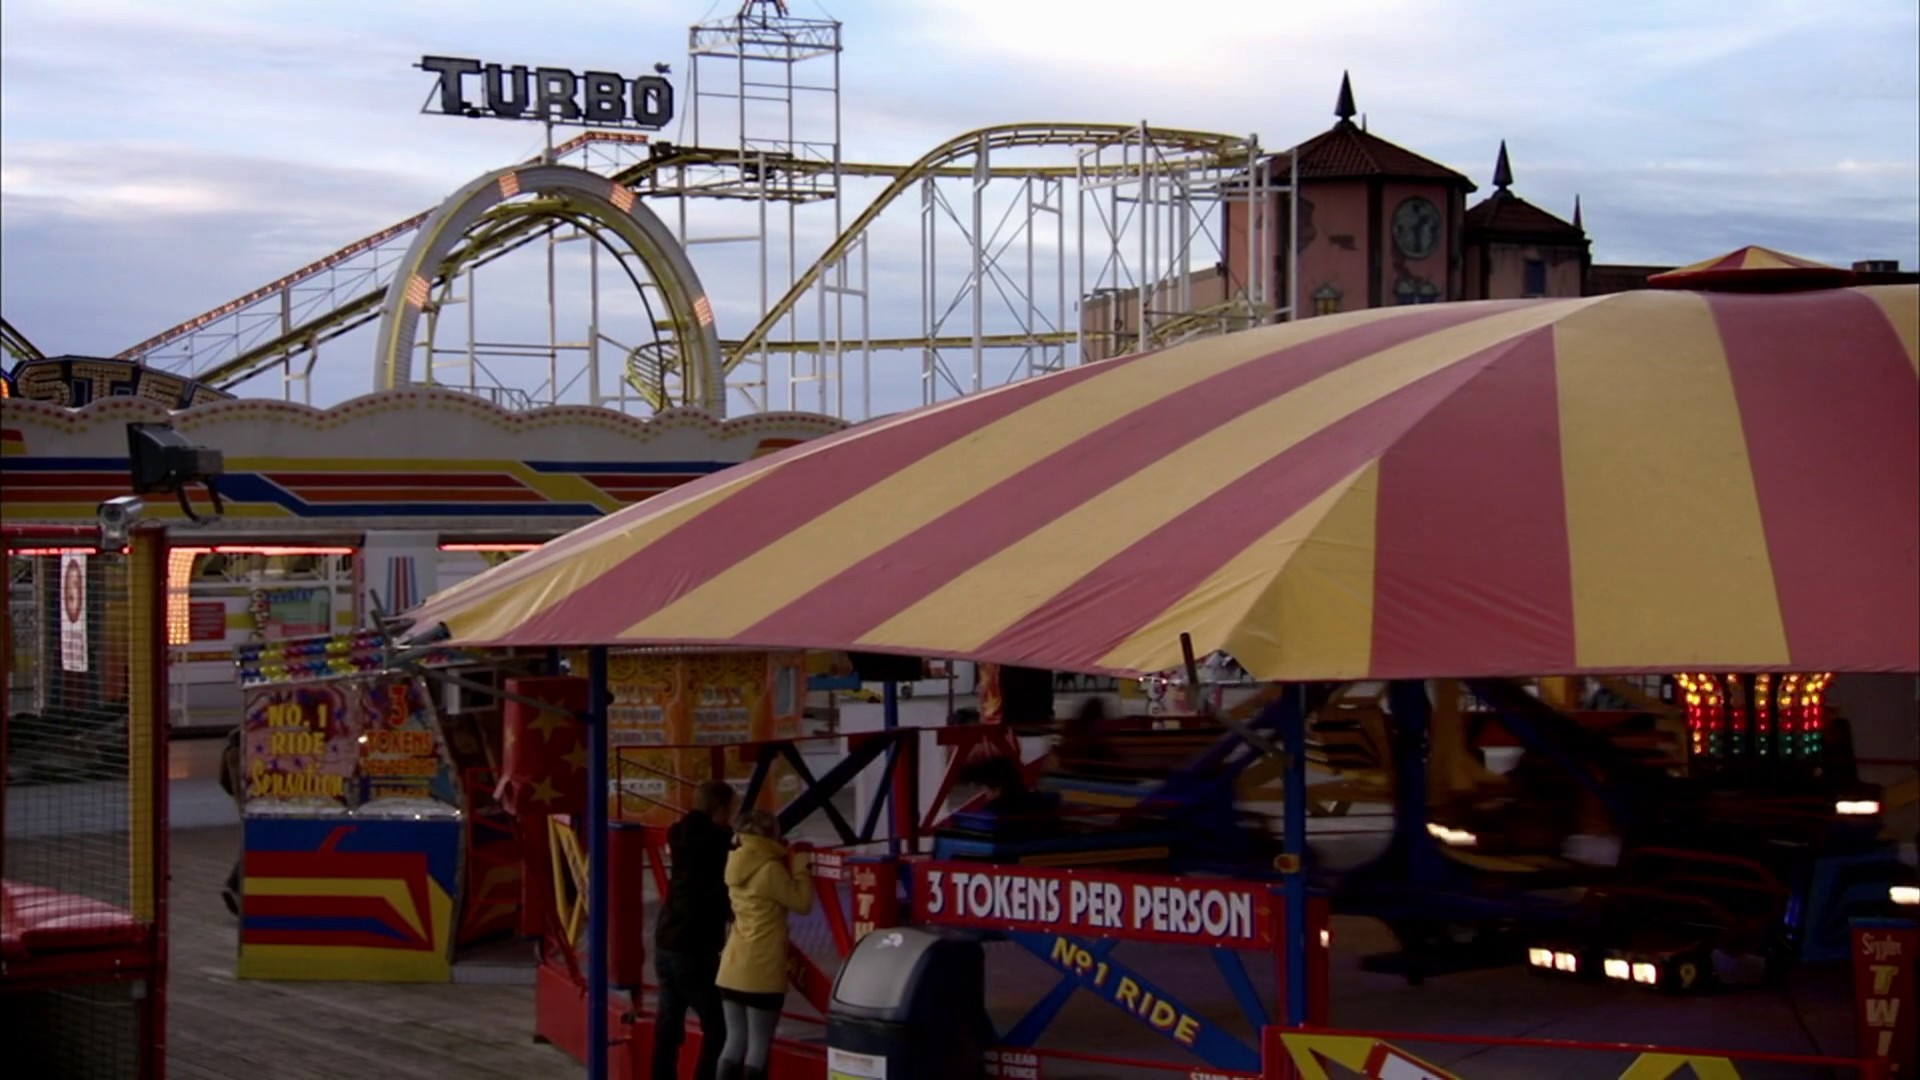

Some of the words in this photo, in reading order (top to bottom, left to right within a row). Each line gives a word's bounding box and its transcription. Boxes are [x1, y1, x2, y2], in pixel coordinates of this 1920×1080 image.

[422, 55, 674, 128] TURBO
[267, 703, 311, 730] NO.
[317, 703, 329, 728] 1
[388, 684, 408, 726] 3
[270, 731, 327, 755] RIDE
[927, 869, 944, 915] 3
[951, 871, 1061, 923] TOKENS
[1068, 879, 1124, 929] PER
[1133, 883, 1252, 939] PERSON
[1679, 962, 1697, 989] 9
[1115, 976, 1200, 1044] RIDE
[1001, 1051, 1039, 1067] CLEAR
[1002, 1065, 1039, 1080] FENCE
